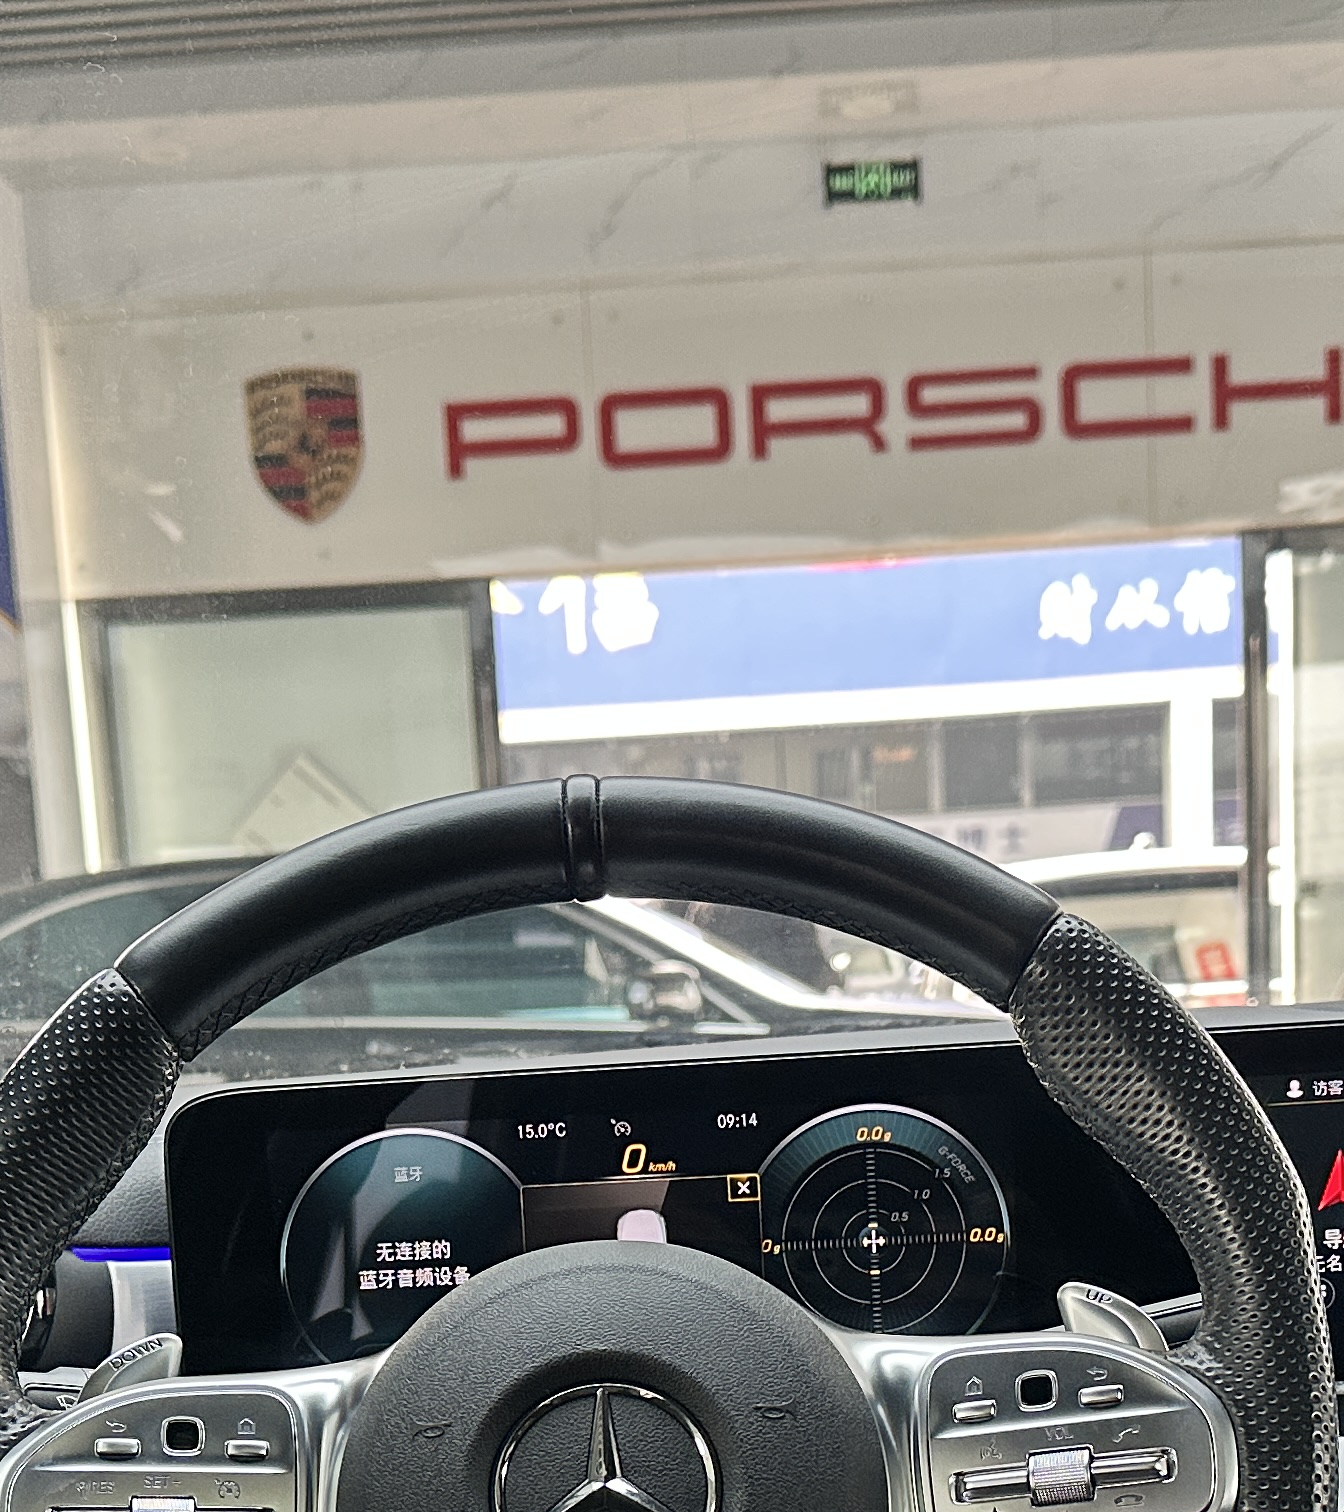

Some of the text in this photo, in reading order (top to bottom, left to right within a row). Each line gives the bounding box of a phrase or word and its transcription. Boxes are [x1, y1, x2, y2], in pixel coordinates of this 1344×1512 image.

[1313, 1080, 1344, 1096] 访客
[717, 1112, 757, 1128] 09:14
[517, 1122, 567, 1139] 15.0°C
[621, 1143, 676, 1174] 0 km/h
[394, 1166, 423, 1182] 蓝牙
[934, 1168, 951, 1179] 1.5
[913, 1189, 931, 1200] 1.0
[891, 1211, 909, 1222] 0.5
[376, 1240, 451, 1262] 无连接的
[358, 1266, 471, 1290] 蓝牙音频设备
[1084, 1288, 1114, 1304] UP
[108, 1338, 163, 1371] DOWN
